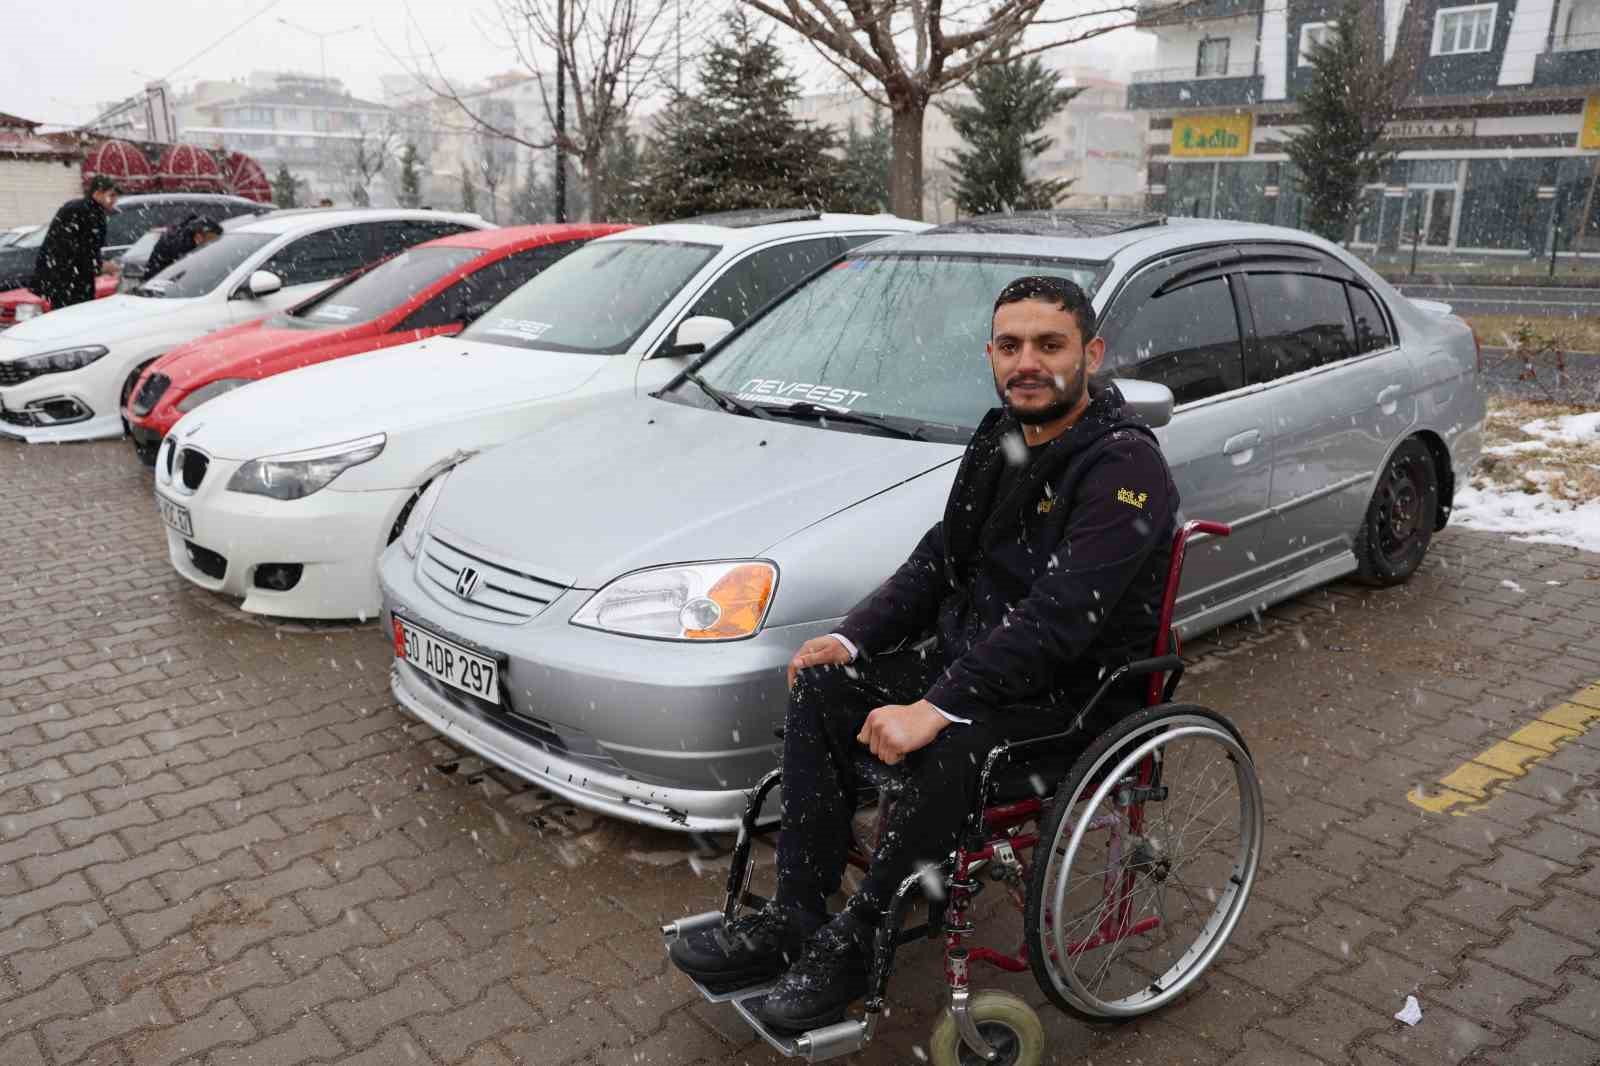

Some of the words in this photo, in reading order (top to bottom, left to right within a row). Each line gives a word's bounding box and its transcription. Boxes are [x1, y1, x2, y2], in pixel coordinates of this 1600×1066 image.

[403, 627, 420, 662] 50
[426, 639, 454, 679] ADR
[459, 655, 494, 696] 297
